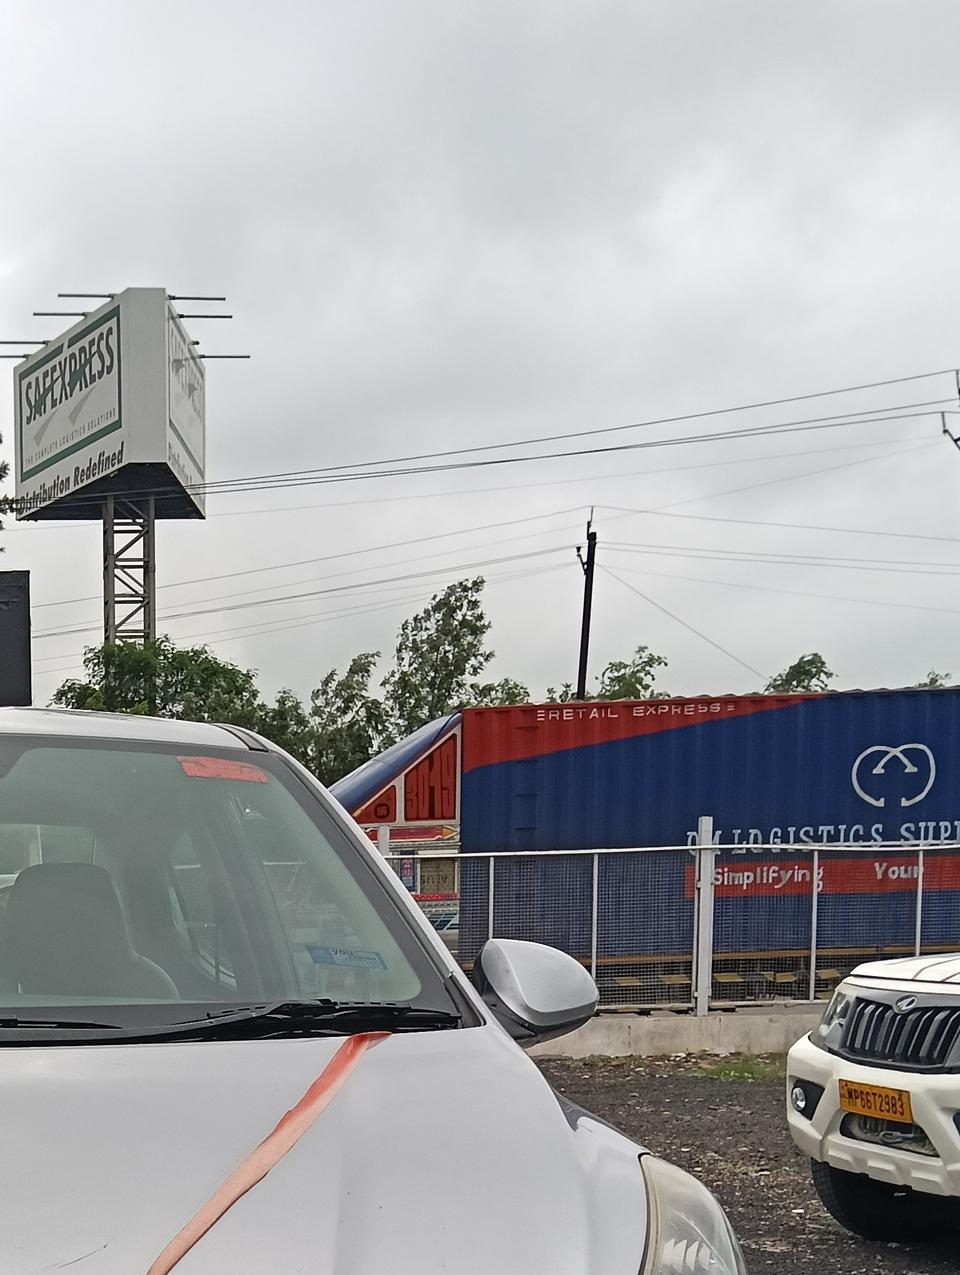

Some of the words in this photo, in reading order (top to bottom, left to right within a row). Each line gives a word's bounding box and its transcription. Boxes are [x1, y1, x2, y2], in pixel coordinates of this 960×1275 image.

[25, 326, 114, 425] SAFEXPRESS
[19, 475, 71, 514] Distribution
[73, 440, 124, 488] Redefined
[548, 708, 619, 721] RETAIL
[632, 703, 721, 717] EXPRESS
[731, 823, 883, 855] LOGISTICS
